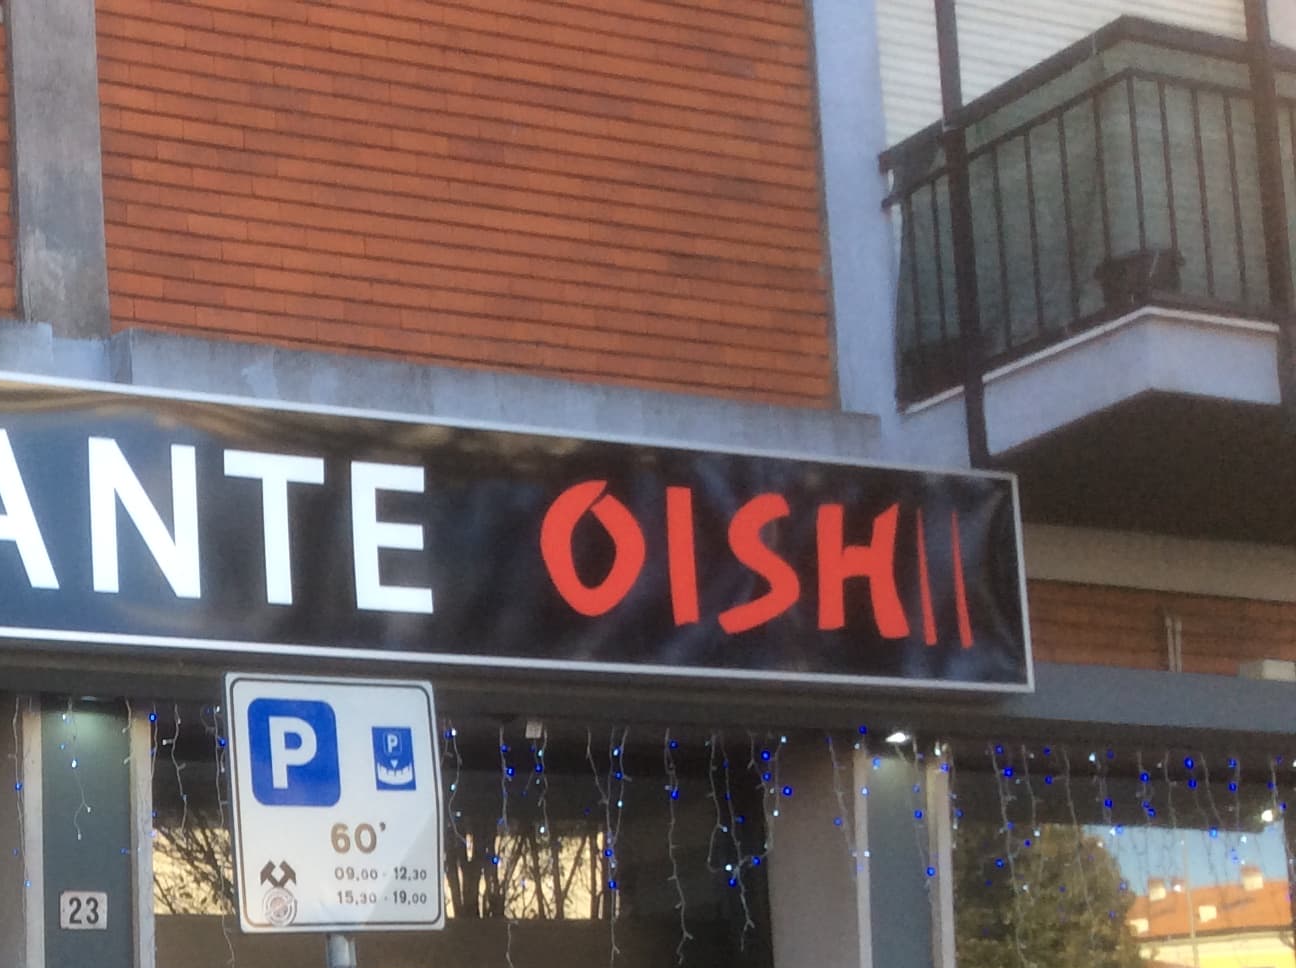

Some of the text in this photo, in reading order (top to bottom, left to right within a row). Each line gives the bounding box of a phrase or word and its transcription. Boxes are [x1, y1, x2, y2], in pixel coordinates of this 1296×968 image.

[268, 715, 317, 789] P
[387, 733, 399, 754] P
[69, 897, 99, 924] 23
